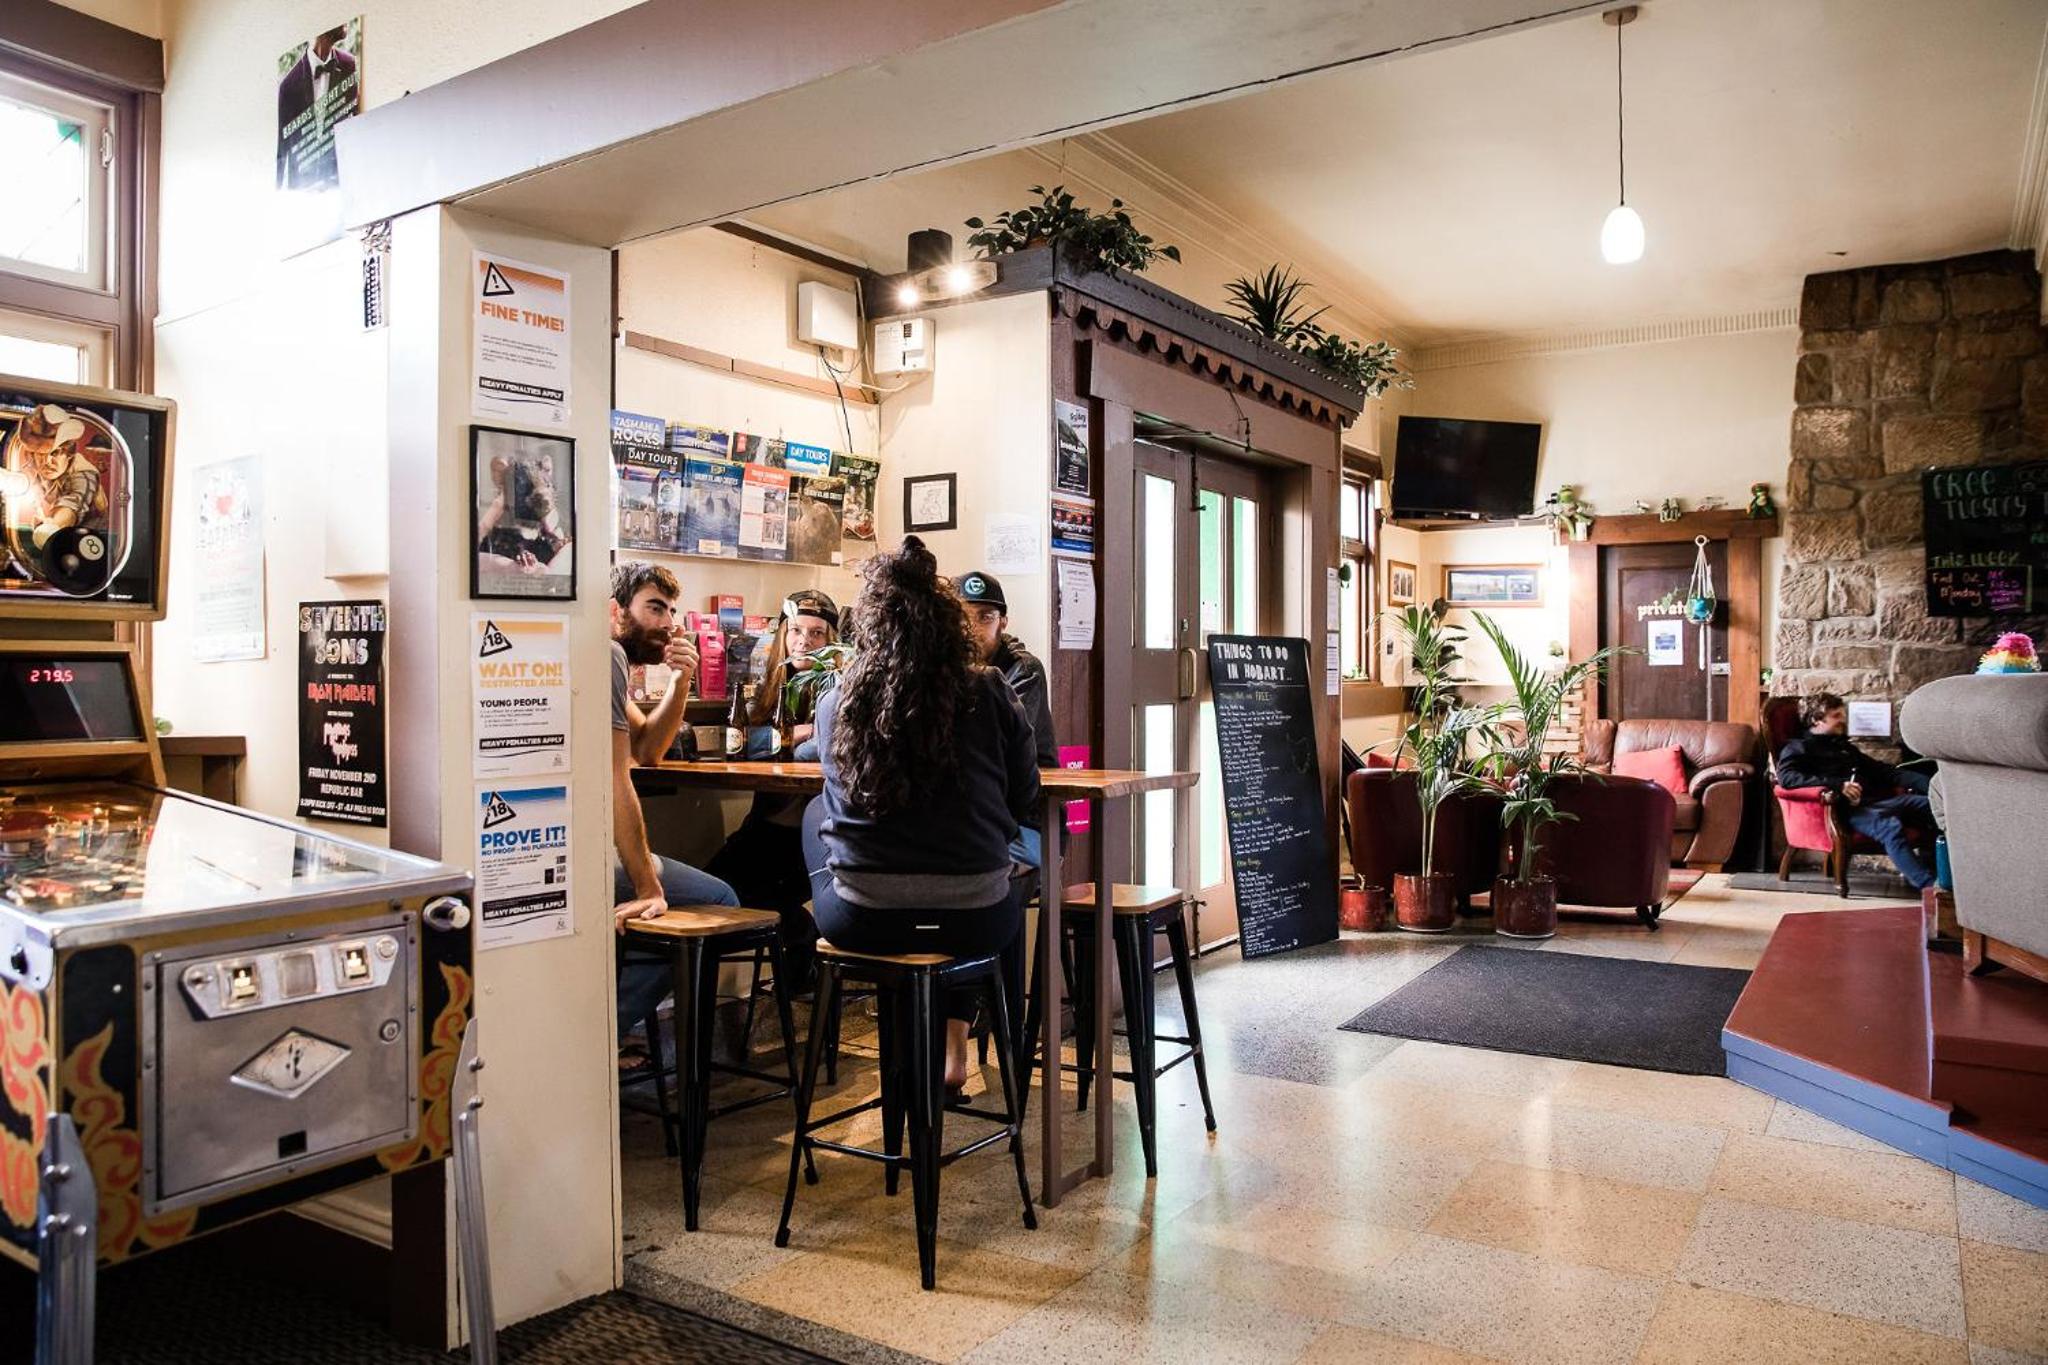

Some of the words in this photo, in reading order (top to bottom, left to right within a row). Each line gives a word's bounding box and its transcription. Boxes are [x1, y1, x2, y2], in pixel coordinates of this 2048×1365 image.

[282, 107, 314, 139] BEARDS
[481, 301, 519, 323] FINE
[522, 310, 566, 332] TIME!
[481, 379, 506, 391] HEAVY
[506, 383, 542, 397] PENALTIES
[542, 389, 563, 399] APPLY
[613, 416, 660, 432] TASMANIA
[613, 427, 661, 446] ROCKS
[628, 449, 647, 460] DAY
[648, 453, 679, 466] TOURS
[790, 446, 805, 457] DAY
[805, 449, 828, 461] TOURS
[86, 537, 99, 555] 8
[299, 605, 385, 632] SEVENTH
[487, 632, 503, 647] 18
[315, 638, 369, 665] SONS
[1213, 642, 1253, 660] THINGS
[1257, 644, 1272, 660] TO
[1274, 646, 1289, 660] DO
[479, 662, 528, 678] WAIT
[531, 662, 563, 677] ON!
[1226, 663, 1239, 680] IN
[333, 683, 376, 706] MAIDEN
[480, 698, 512, 708] YOUNG
[514, 698, 548, 707] PEOPLE
[481, 739, 506, 748] HEAVY
[506, 737, 542, 747] PENALTIES
[543, 736, 563, 744] APPLY
[308, 766, 330, 779] FRIDAY
[330, 769, 363, 782] NOVEMBER
[320, 782, 350, 797] REPUBLIC
[350, 786, 364, 798] BAR
[491, 802, 508, 818] 18
[481, 829, 542, 848] PROVE
[544, 825, 567, 842] IT!
[481, 849, 492, 857] NO
[493, 846, 516, 856] PROOF
[532, 841, 567, 851] PURCHASE
[484, 909, 509, 919] HEAVY
[508, 903, 544, 915] PENALTIES
[544, 899, 565, 909] APPLY
